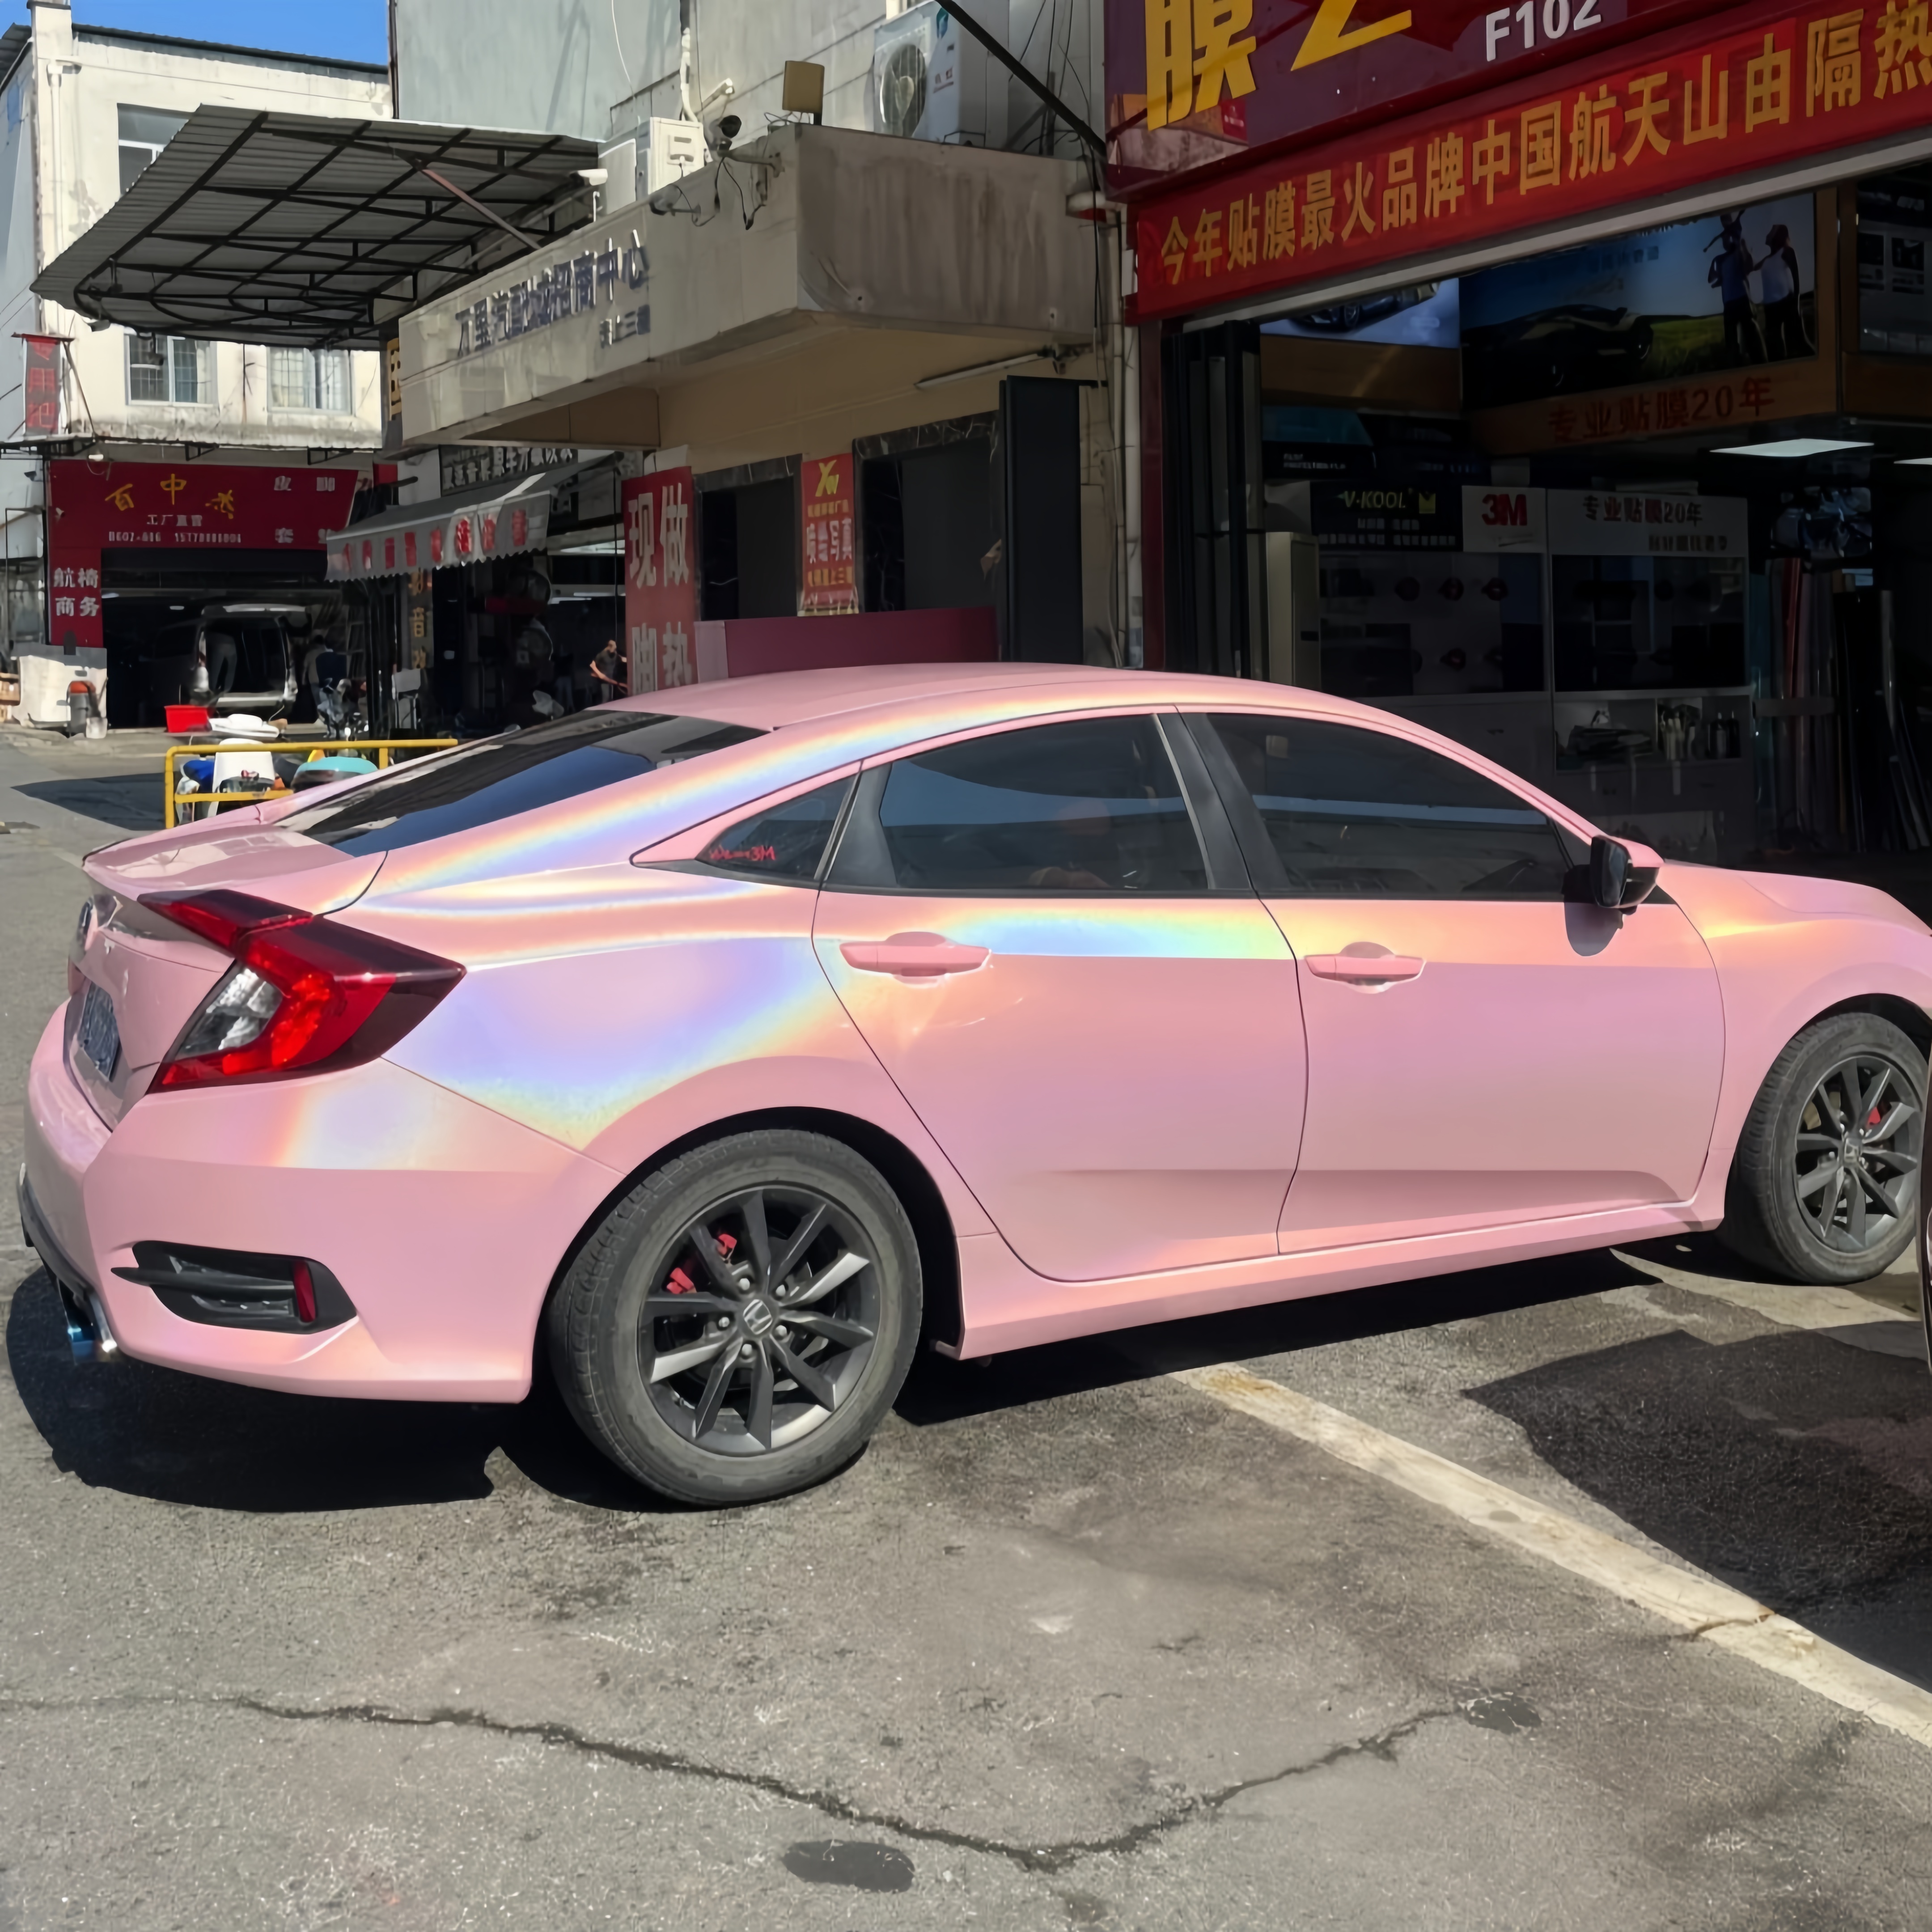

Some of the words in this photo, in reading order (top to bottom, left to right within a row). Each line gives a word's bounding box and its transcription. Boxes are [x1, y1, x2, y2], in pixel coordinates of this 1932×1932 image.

[1486, 0, 1601, 62] F102
[1548, 377, 1775, 443] 专业贴膜20年
[146, 514, 203, 527] 工厂
[1481, 494, 1527, 526] 3M
[628, 482, 689, 589] 现做
[55, 596, 100, 617] 商务
